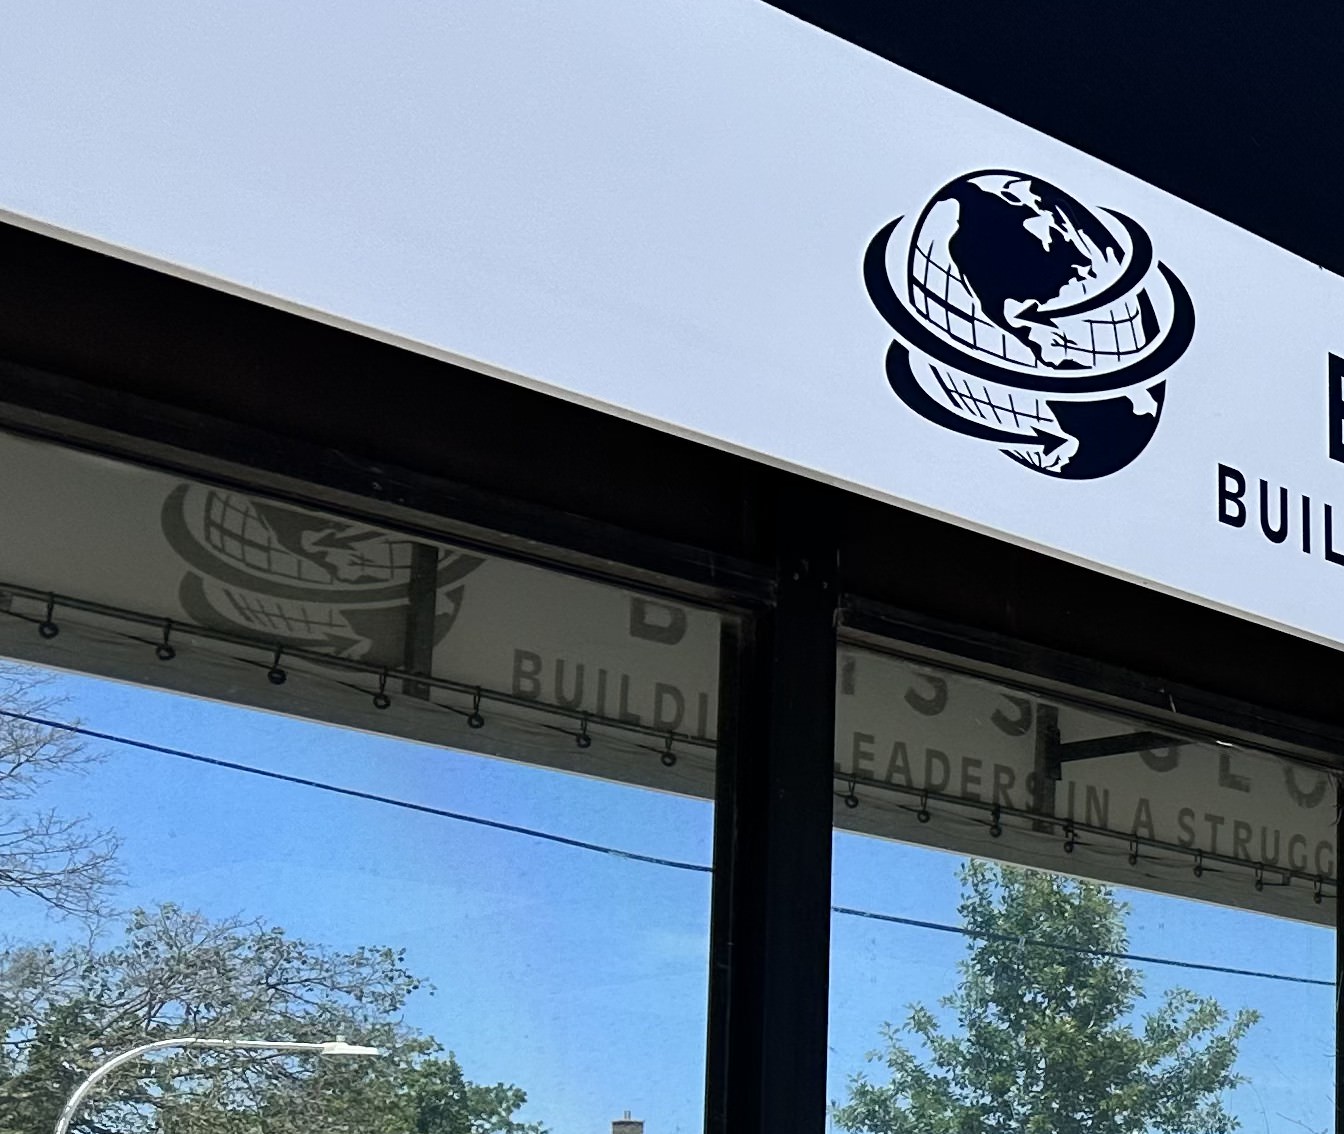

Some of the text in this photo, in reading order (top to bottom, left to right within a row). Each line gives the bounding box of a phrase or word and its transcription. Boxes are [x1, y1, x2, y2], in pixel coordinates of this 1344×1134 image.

[512, 648, 710, 738] BUILDI
[1066, 780, 1109, 830] IN
[1176, 807, 1335, 878] STRUGG
